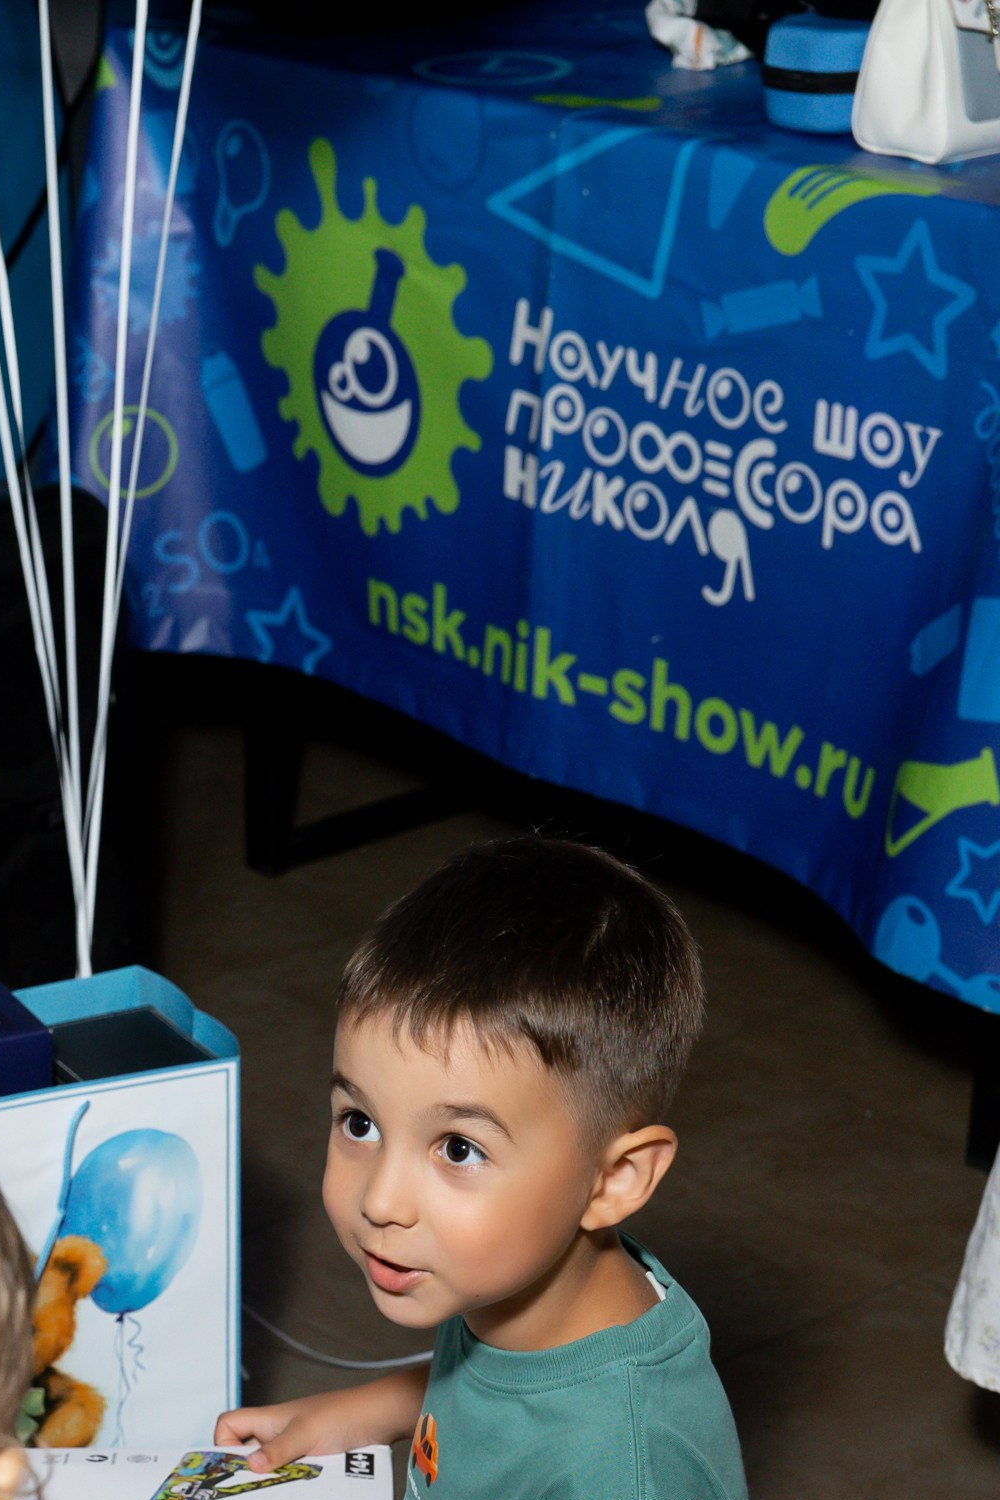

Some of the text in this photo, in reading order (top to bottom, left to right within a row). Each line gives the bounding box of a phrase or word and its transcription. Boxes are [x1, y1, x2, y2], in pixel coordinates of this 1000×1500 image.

[813, 398, 943, 489] шоу
[367, 577, 875, 819] nsk.nik-show.ru
[350, 1453, 370, 1474] 14+
